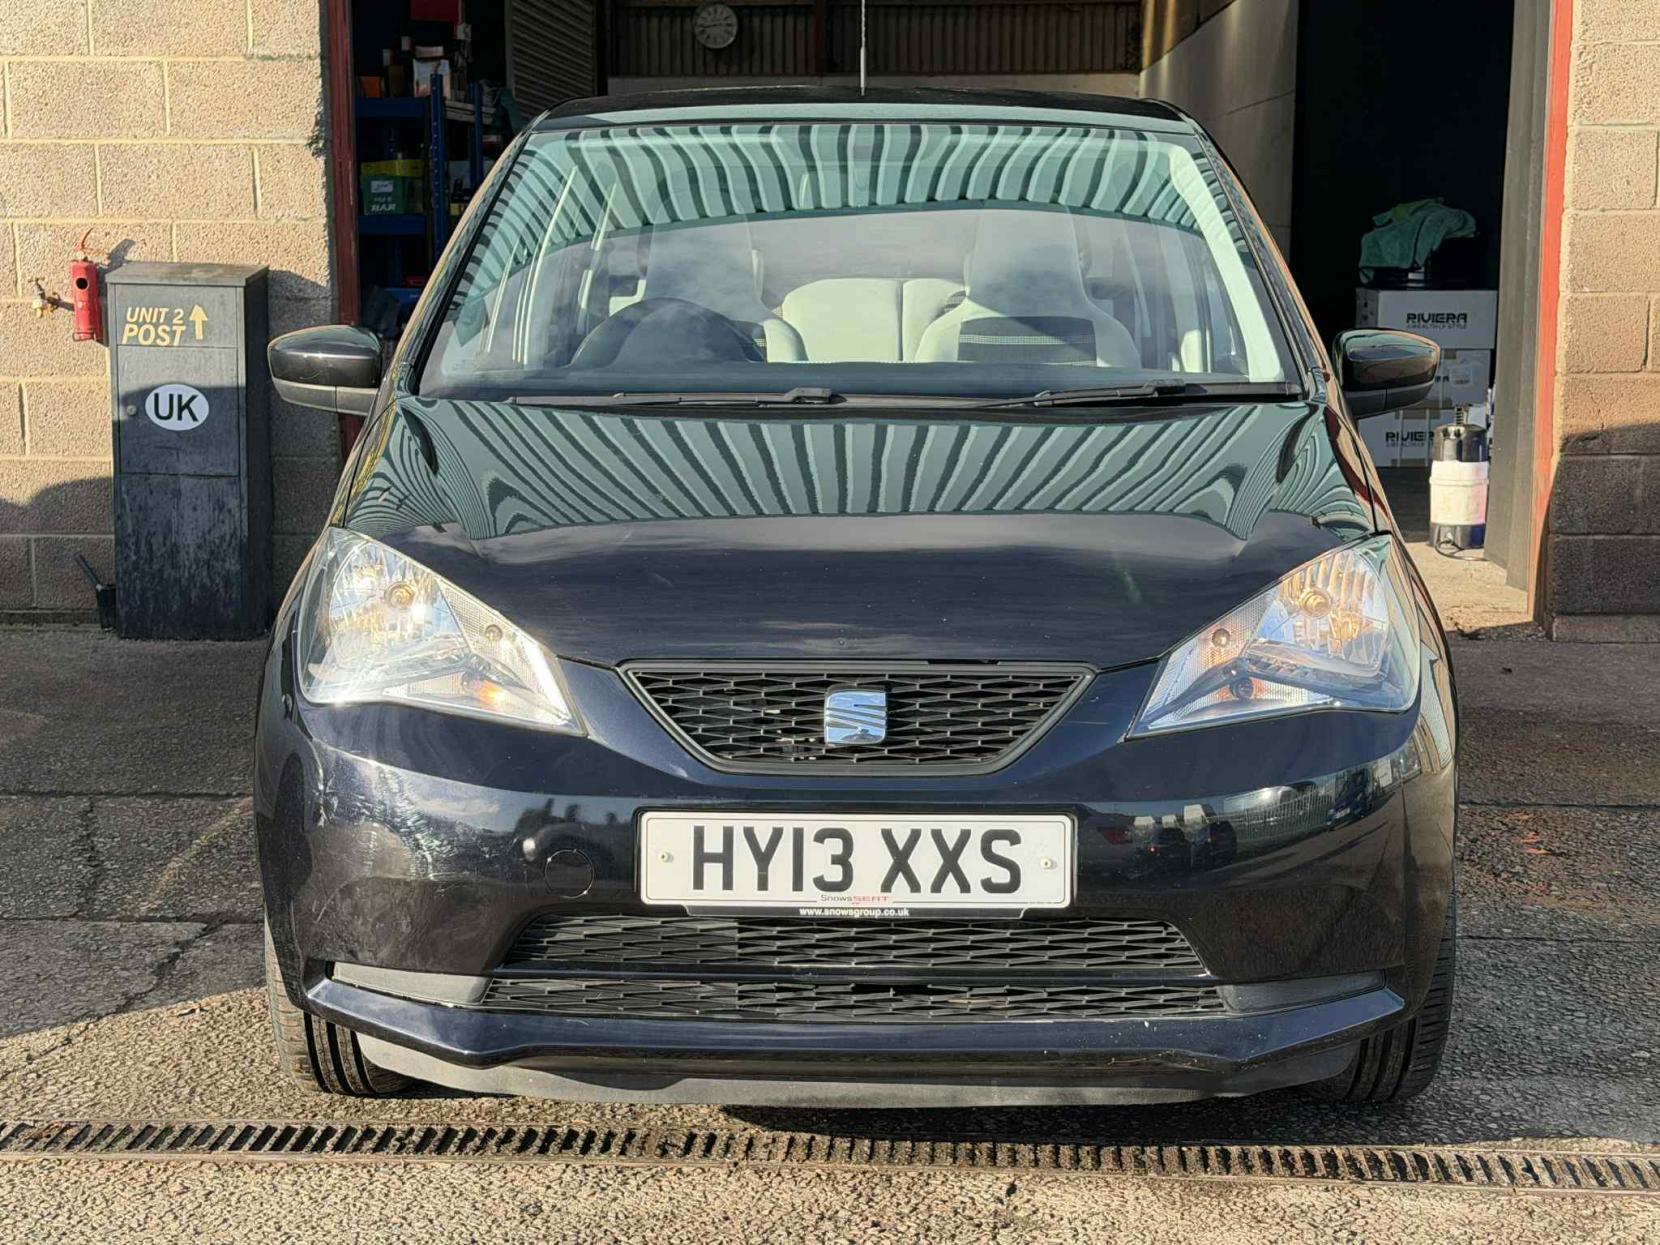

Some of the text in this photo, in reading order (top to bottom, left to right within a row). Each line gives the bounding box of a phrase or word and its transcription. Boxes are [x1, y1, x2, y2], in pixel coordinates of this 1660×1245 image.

[126, 307, 185, 324] UNIT 2
[1406, 312, 1468, 324] RIVIERA
[121, 323, 187, 346] POST
[153, 393, 199, 422] UK
[1385, 431, 1435, 442] RIVIER
[692, 825, 1022, 894] HY13 XXS
[799, 908, 910, 918] www.snowsgroup.co.uk
